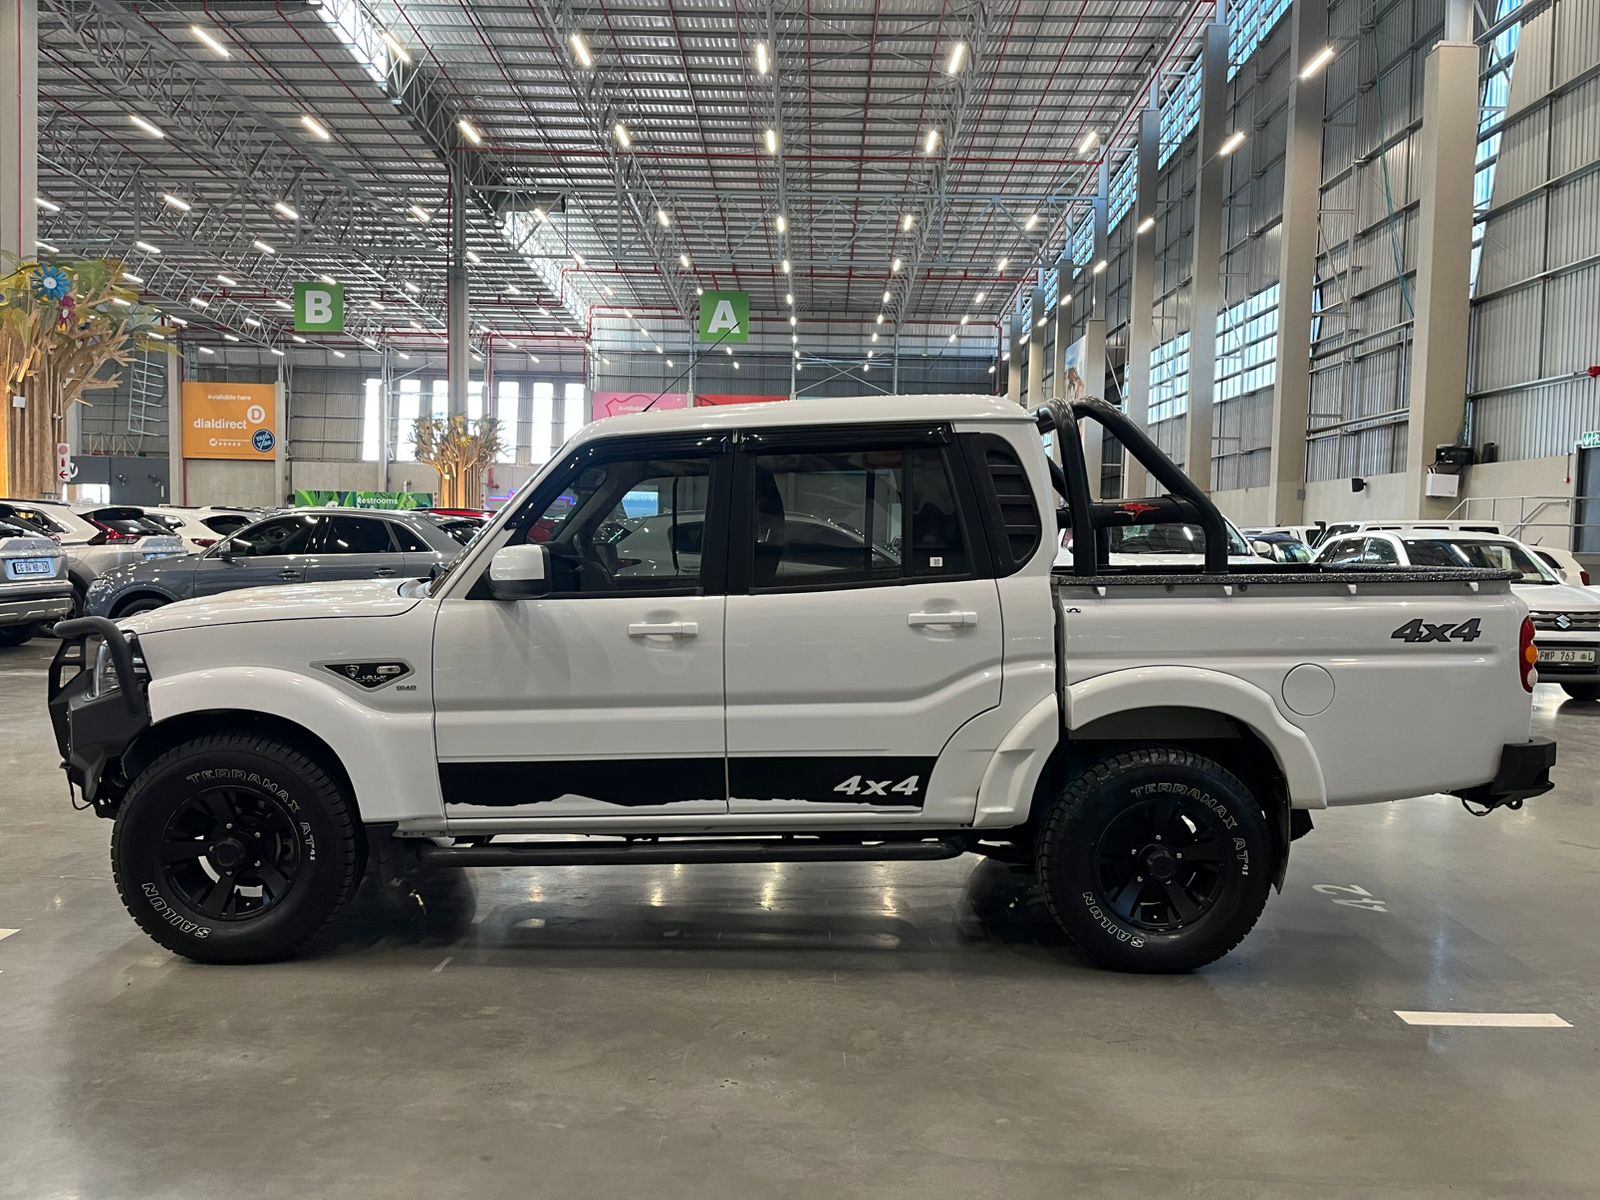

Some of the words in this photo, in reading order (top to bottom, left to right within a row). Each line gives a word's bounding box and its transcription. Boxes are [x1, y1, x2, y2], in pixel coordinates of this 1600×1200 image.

[305, 290, 333, 324] B
[707, 300, 741, 334] A
[207, 393, 236, 401] Available
[193, 418, 247, 430] dialdirect
[251, 408, 262, 421] D
[357, 495, 398, 505] Restrooms
[1391, 618, 1481, 642] 4x4
[1540, 651, 1555, 660] FMP
[1560, 651, 1576, 661] 763
[1588, 652, 1593, 661] L
[186, 768, 300, 814] TERRAMAX
[833, 775, 920, 796] 4x4
[1130, 782, 1239, 830] TERRAMAX
[141, 882, 212, 939] SAILUN
[1082, 891, 1146, 949] SAILUN
